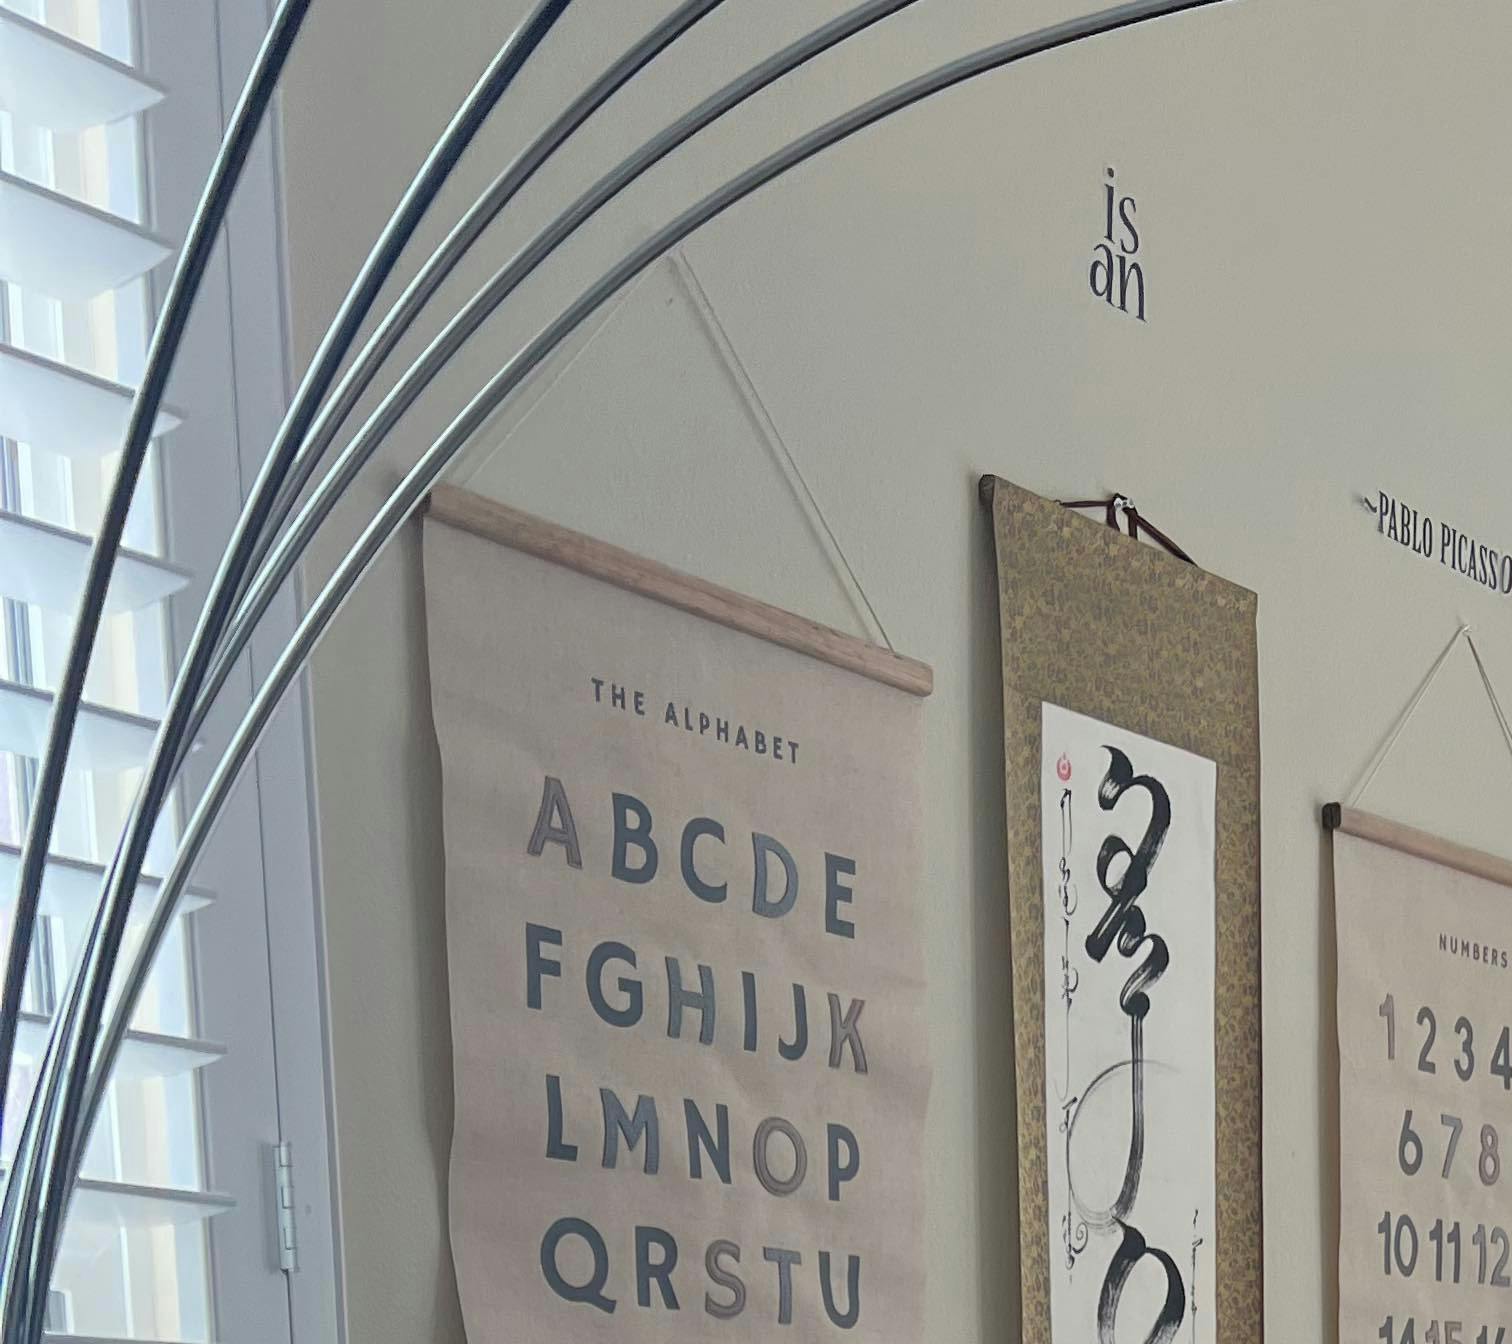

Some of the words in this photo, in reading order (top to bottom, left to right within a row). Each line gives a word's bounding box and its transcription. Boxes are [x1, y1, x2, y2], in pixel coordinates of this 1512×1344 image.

[1104, 167, 1139, 254] is
[1090, 243, 1147, 323] an
[591, 677, 645, 715] THE
[665, 702, 799, 764] ALPHABET
[1438, 933, 1509, 968] NUMBERS
[1377, 1211, 1419, 1278] 10
[1429, 1219, 1461, 1284] 11
[1472, 1224, 1511, 1288] 12
